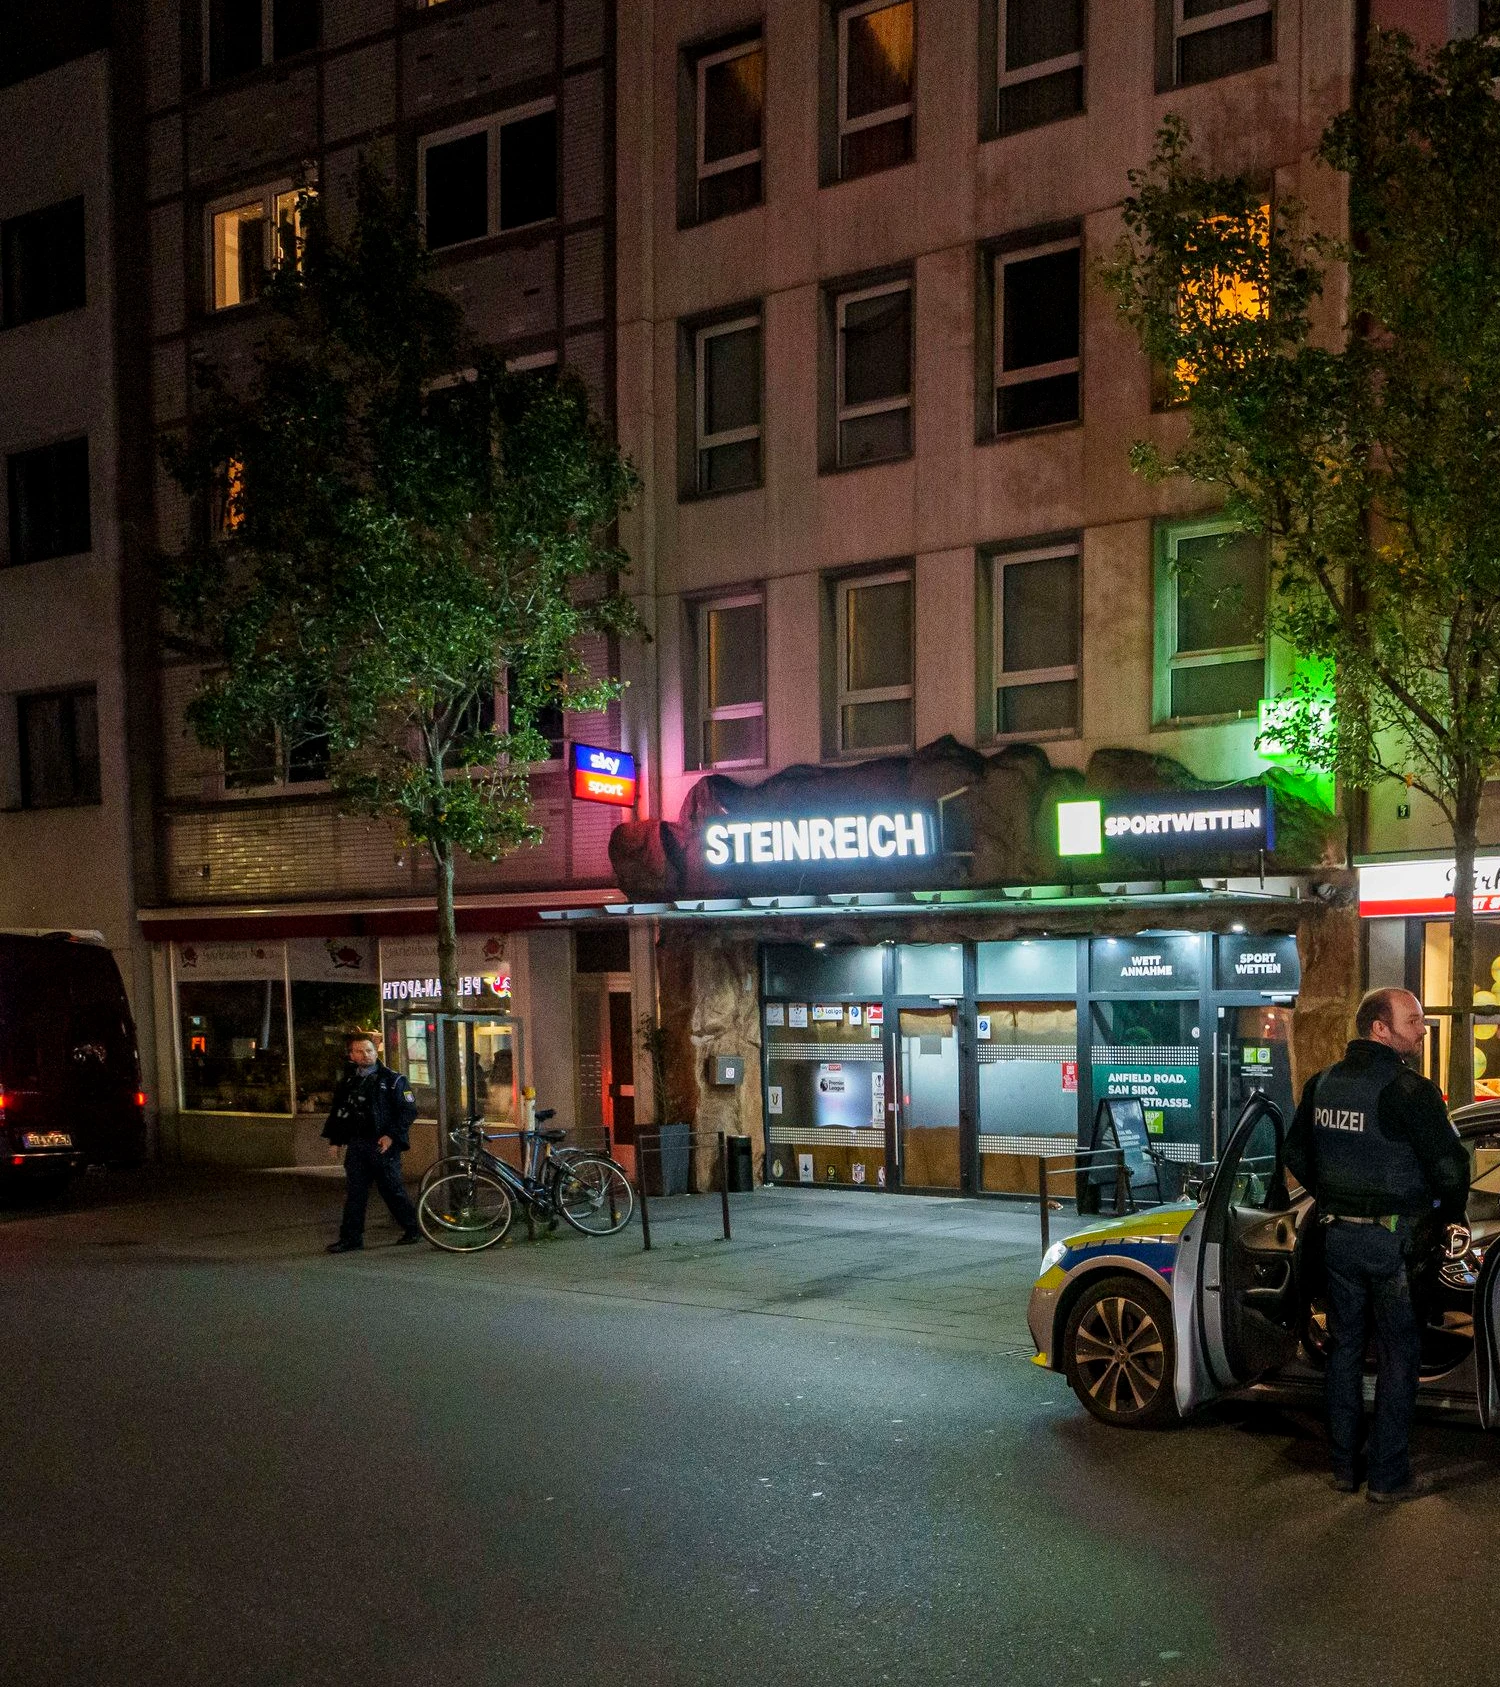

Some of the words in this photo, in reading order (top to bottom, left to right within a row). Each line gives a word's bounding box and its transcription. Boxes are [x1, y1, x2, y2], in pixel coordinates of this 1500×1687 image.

[590, 752, 620, 775] sky
[588, 781, 623, 796] sport
[1104, 808, 1261, 836] SPORTWETTEN
[706, 812, 926, 865] STEINREICH
[1131, 955, 1161, 966] WETT
[1240, 953, 1276, 964] SPORT
[1121, 965, 1172, 977] ANNAHME
[1235, 964, 1281, 975] WETTEN
[1108, 1073, 1151, 1083] ANFIELD
[1153, 1073, 1187, 1084] ROAD.
[1108, 1085, 1129, 1095] SAN
[1131, 1085, 1158, 1095] SIRO.
[1141, 1097, 1192, 1108] STRASSE.
[1315, 1107, 1364, 1132] POLIZEI
